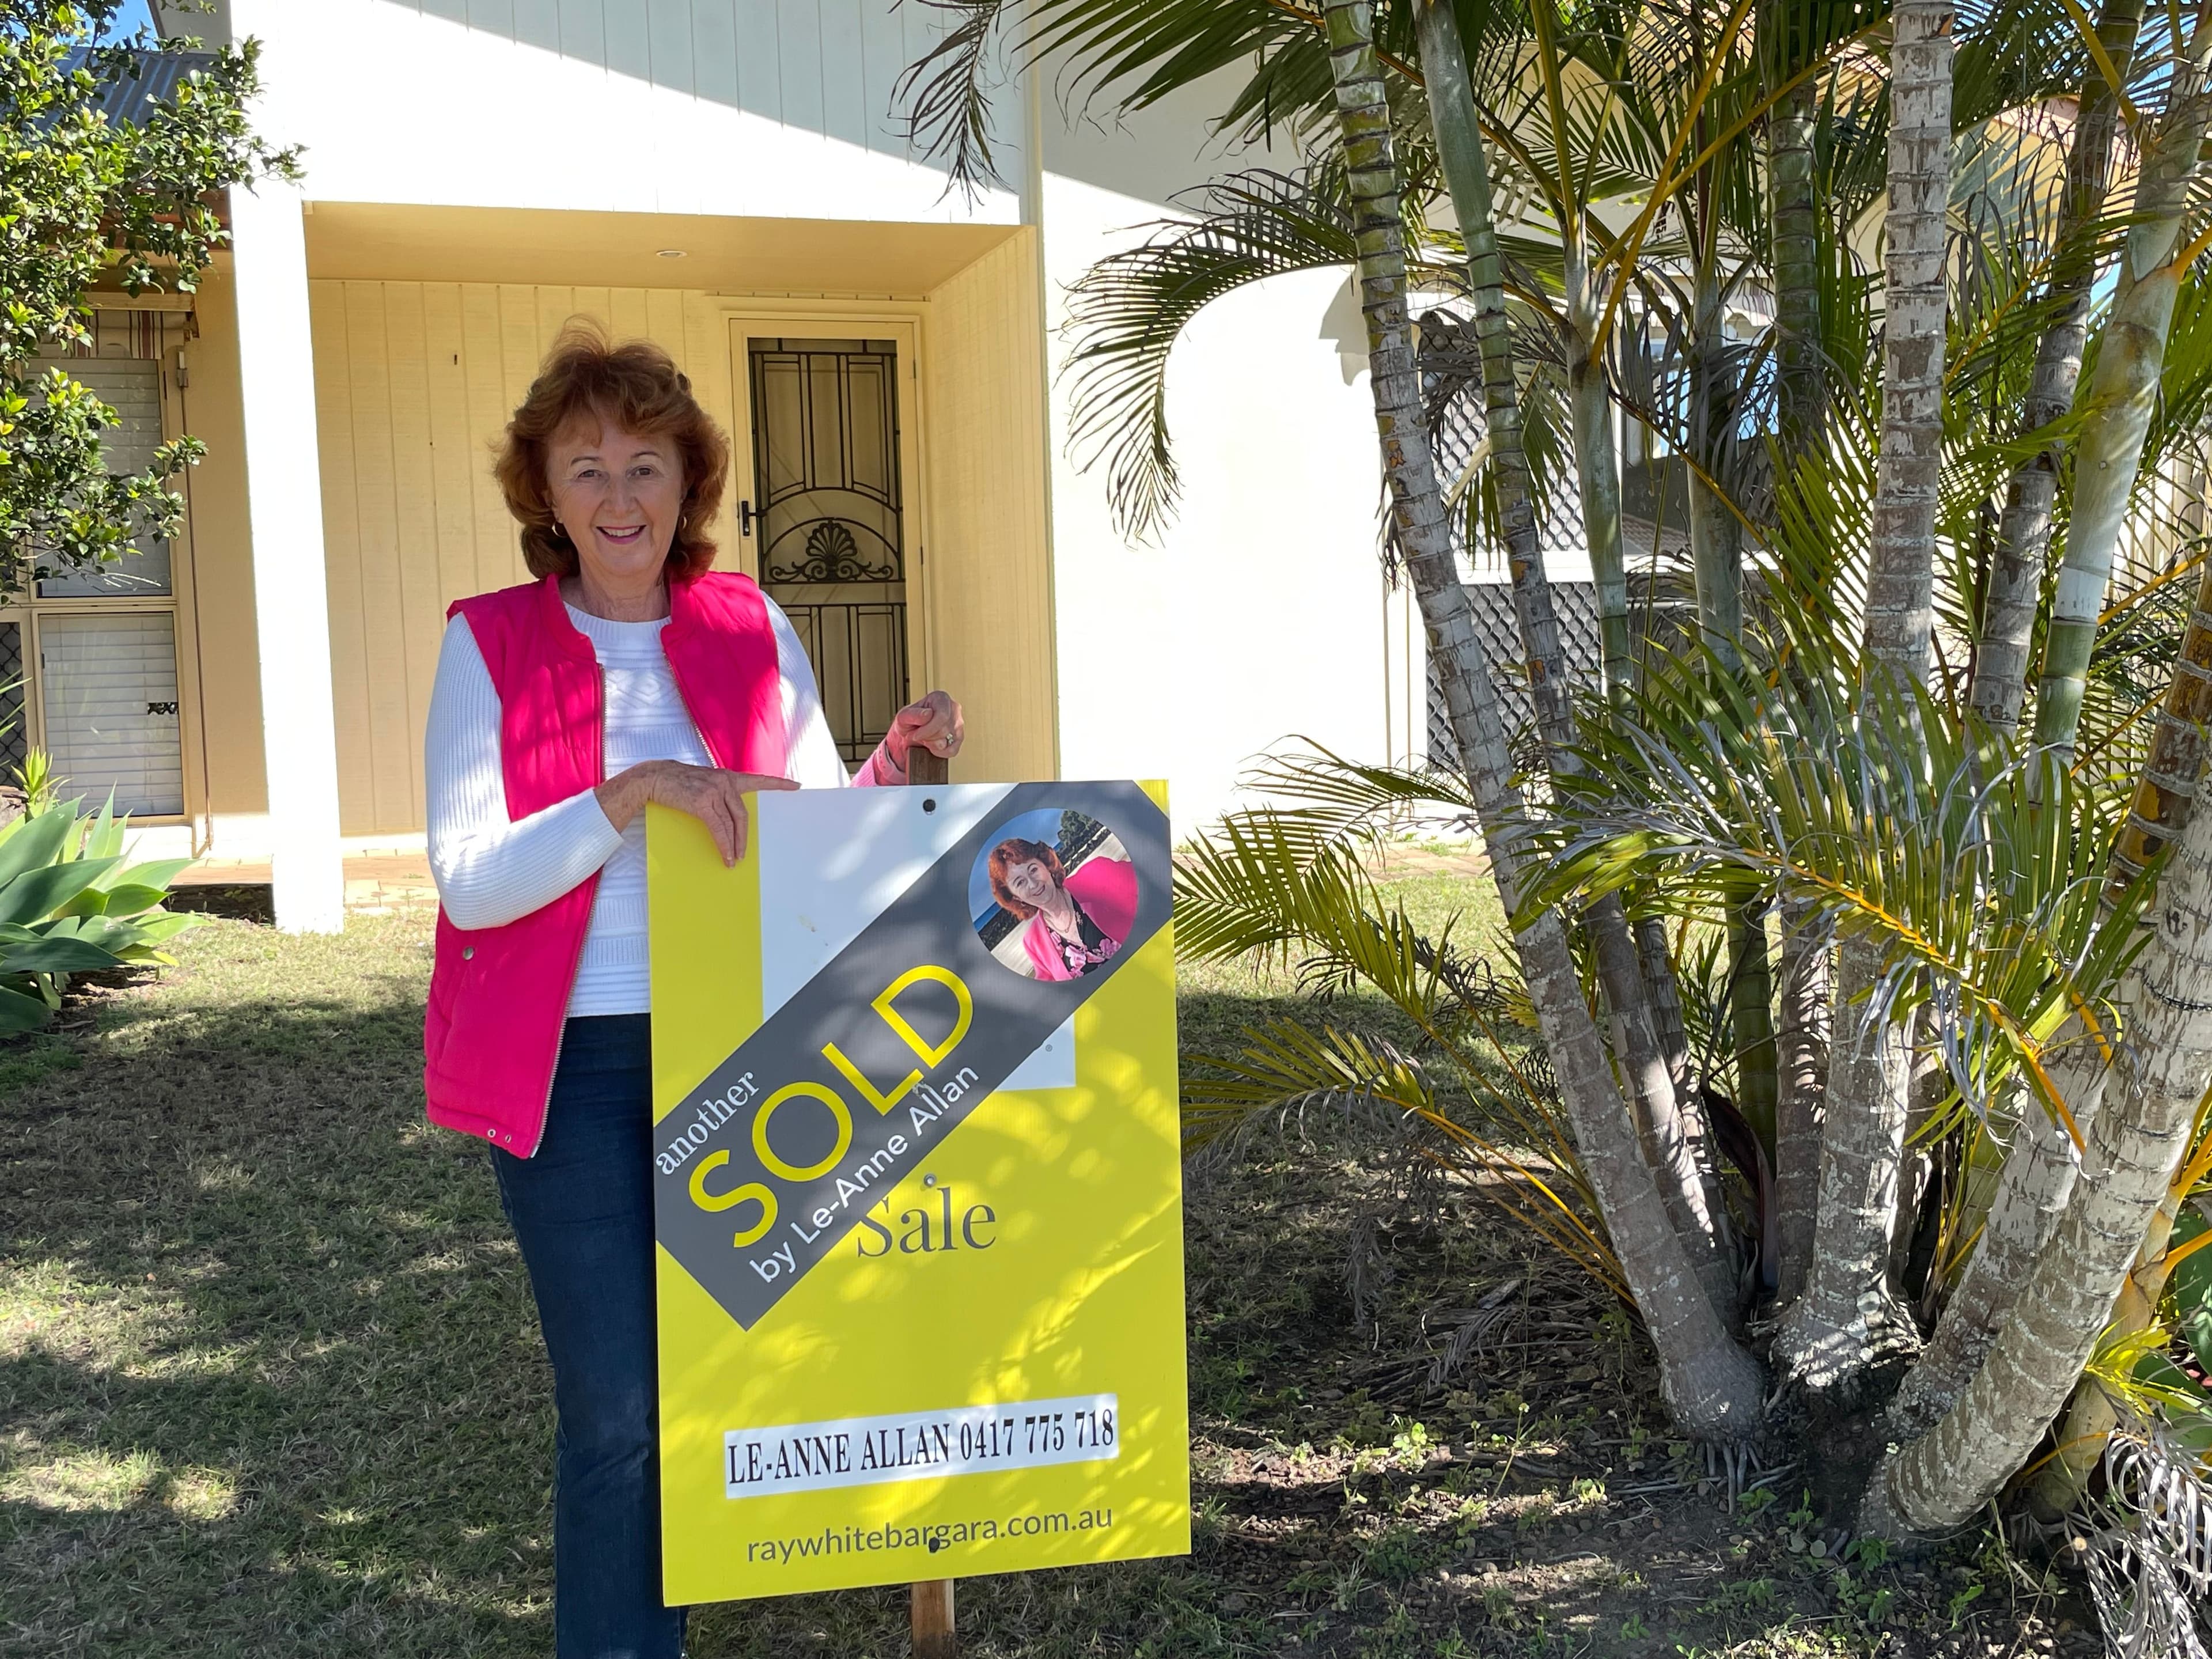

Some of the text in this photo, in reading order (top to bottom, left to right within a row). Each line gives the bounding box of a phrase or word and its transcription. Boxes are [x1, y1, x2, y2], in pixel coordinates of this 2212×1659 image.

[655, 1071, 759, 1175] another
[689, 964, 974, 1248] SOLD
[749, 1066, 979, 1283] by Le-Anne Allan
[728, 1408, 1115, 1484] LE-ANNE ALLAN 0417 775 718
[747, 1506, 1113, 1565] raywhitebargara.com.au
